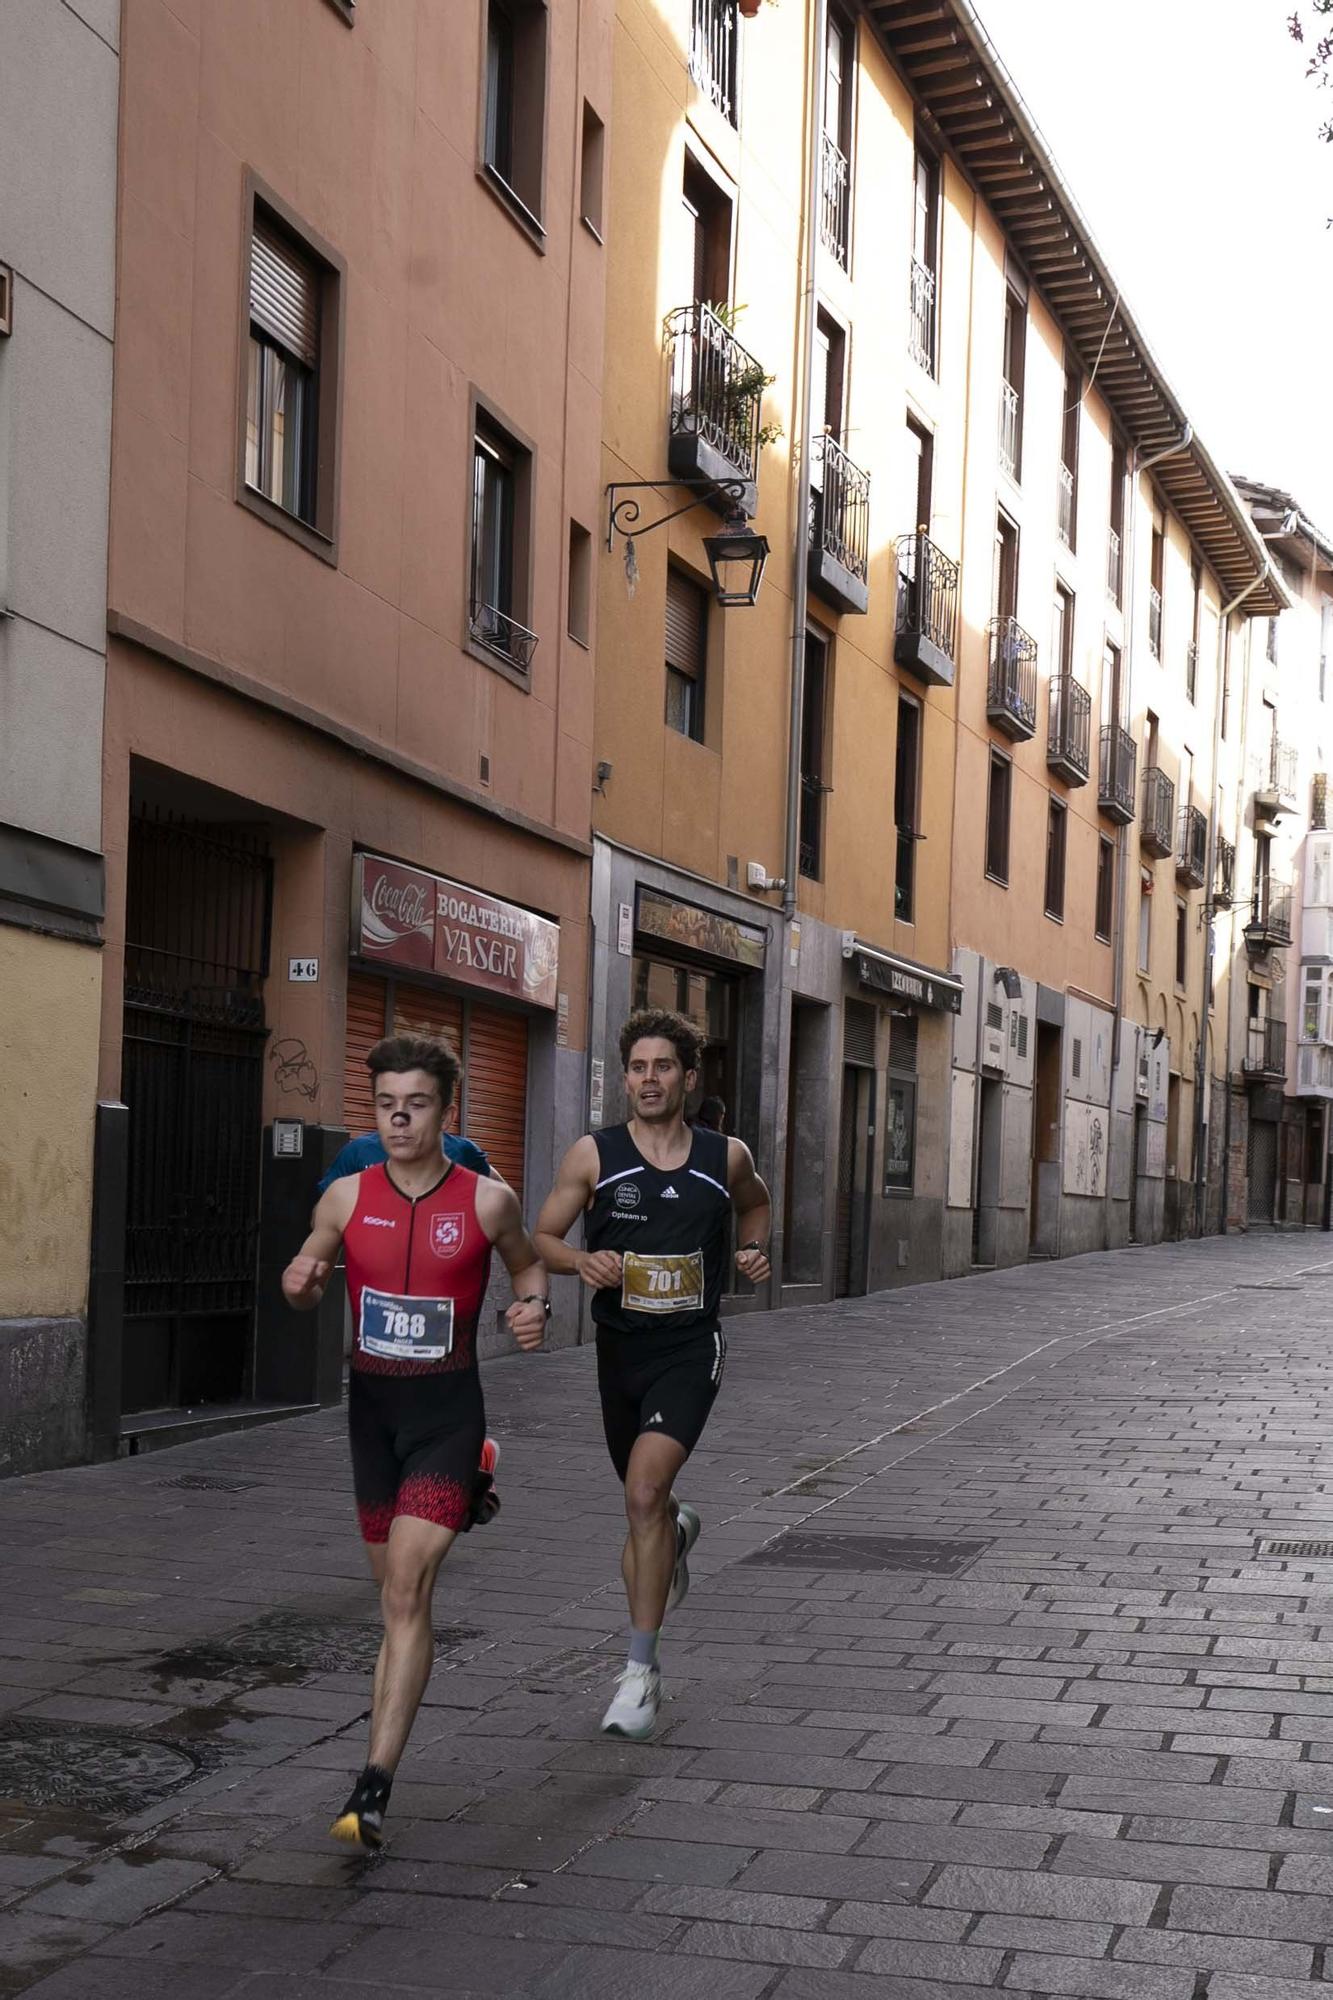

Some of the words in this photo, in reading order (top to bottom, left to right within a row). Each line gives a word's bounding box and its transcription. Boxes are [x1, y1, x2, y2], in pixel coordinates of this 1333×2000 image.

[437, 892, 524, 942] BOCATERIA
[443, 924, 518, 979] YASER
[291, 961, 317, 977] 46
[611, 1211, 640, 1221] Opteam
[647, 1269, 682, 1292] 701
[382, 1309, 426, 1339] 788
